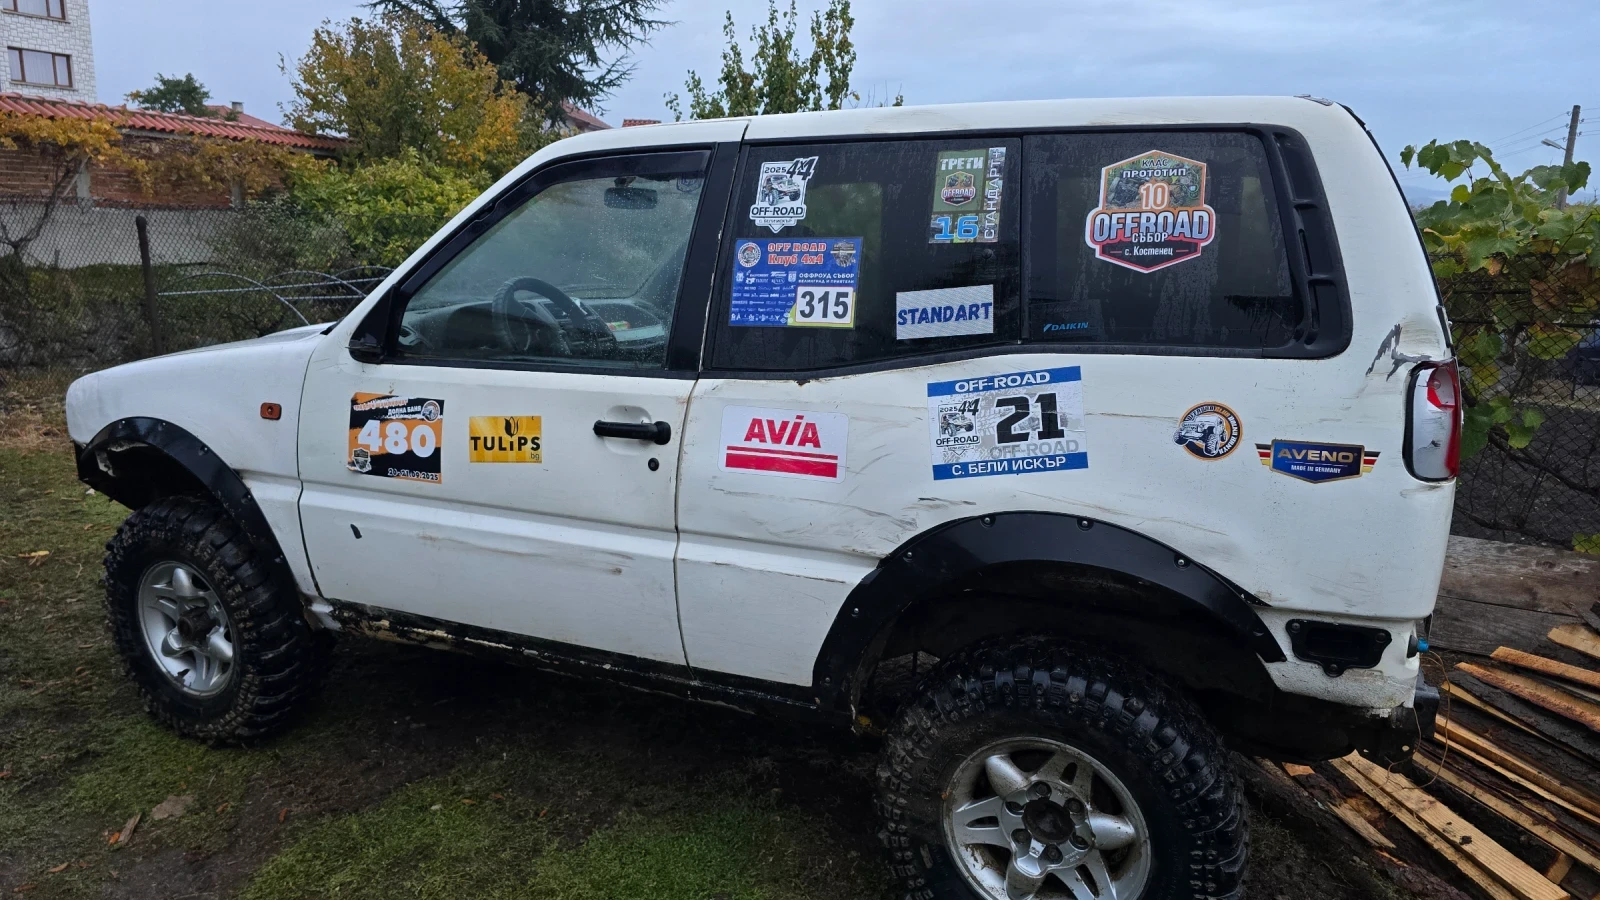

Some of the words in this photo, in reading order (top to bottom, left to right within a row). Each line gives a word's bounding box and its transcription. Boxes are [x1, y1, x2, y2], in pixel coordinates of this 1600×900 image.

[764, 166, 786, 174] 2025
[940, 156, 984, 171] ТРЕТИ
[1141, 158, 1169, 168] КЛАС
[1122, 168, 1186, 178] ПРОТОТИП
[1141, 182, 1169, 210] 10
[751, 207, 804, 216] OFF-ROAD
[934, 215, 979, 240] 16
[1093, 210, 1210, 242] OFFROAD
[1132, 232, 1168, 243] СЪБОР
[767, 242, 791, 252] OFF
[792, 242, 827, 252] ROAD
[1124, 247, 1132, 256] с.
[1133, 246, 1173, 256] Костенец
[767, 253, 798, 267] Клуб
[799, 290, 849, 320] 315
[897, 302, 993, 326] STANDART
[1051, 322, 1089, 331] DAIKIN
[954, 371, 1050, 393] OFF-ROAD
[995, 392, 1065, 445] 21
[357, 419, 436, 458] 480
[936, 436, 979, 445] OFF-ROAD
[530, 452, 540, 461] bg
[989, 439, 1080, 460] OFF-ROAD
[952, 464, 965, 476] С.
[968, 461, 1009, 474] БЕЛИ
[1012, 456, 1067, 471] ИСКЪР
[1314, 466, 1341, 474] GERMANY
